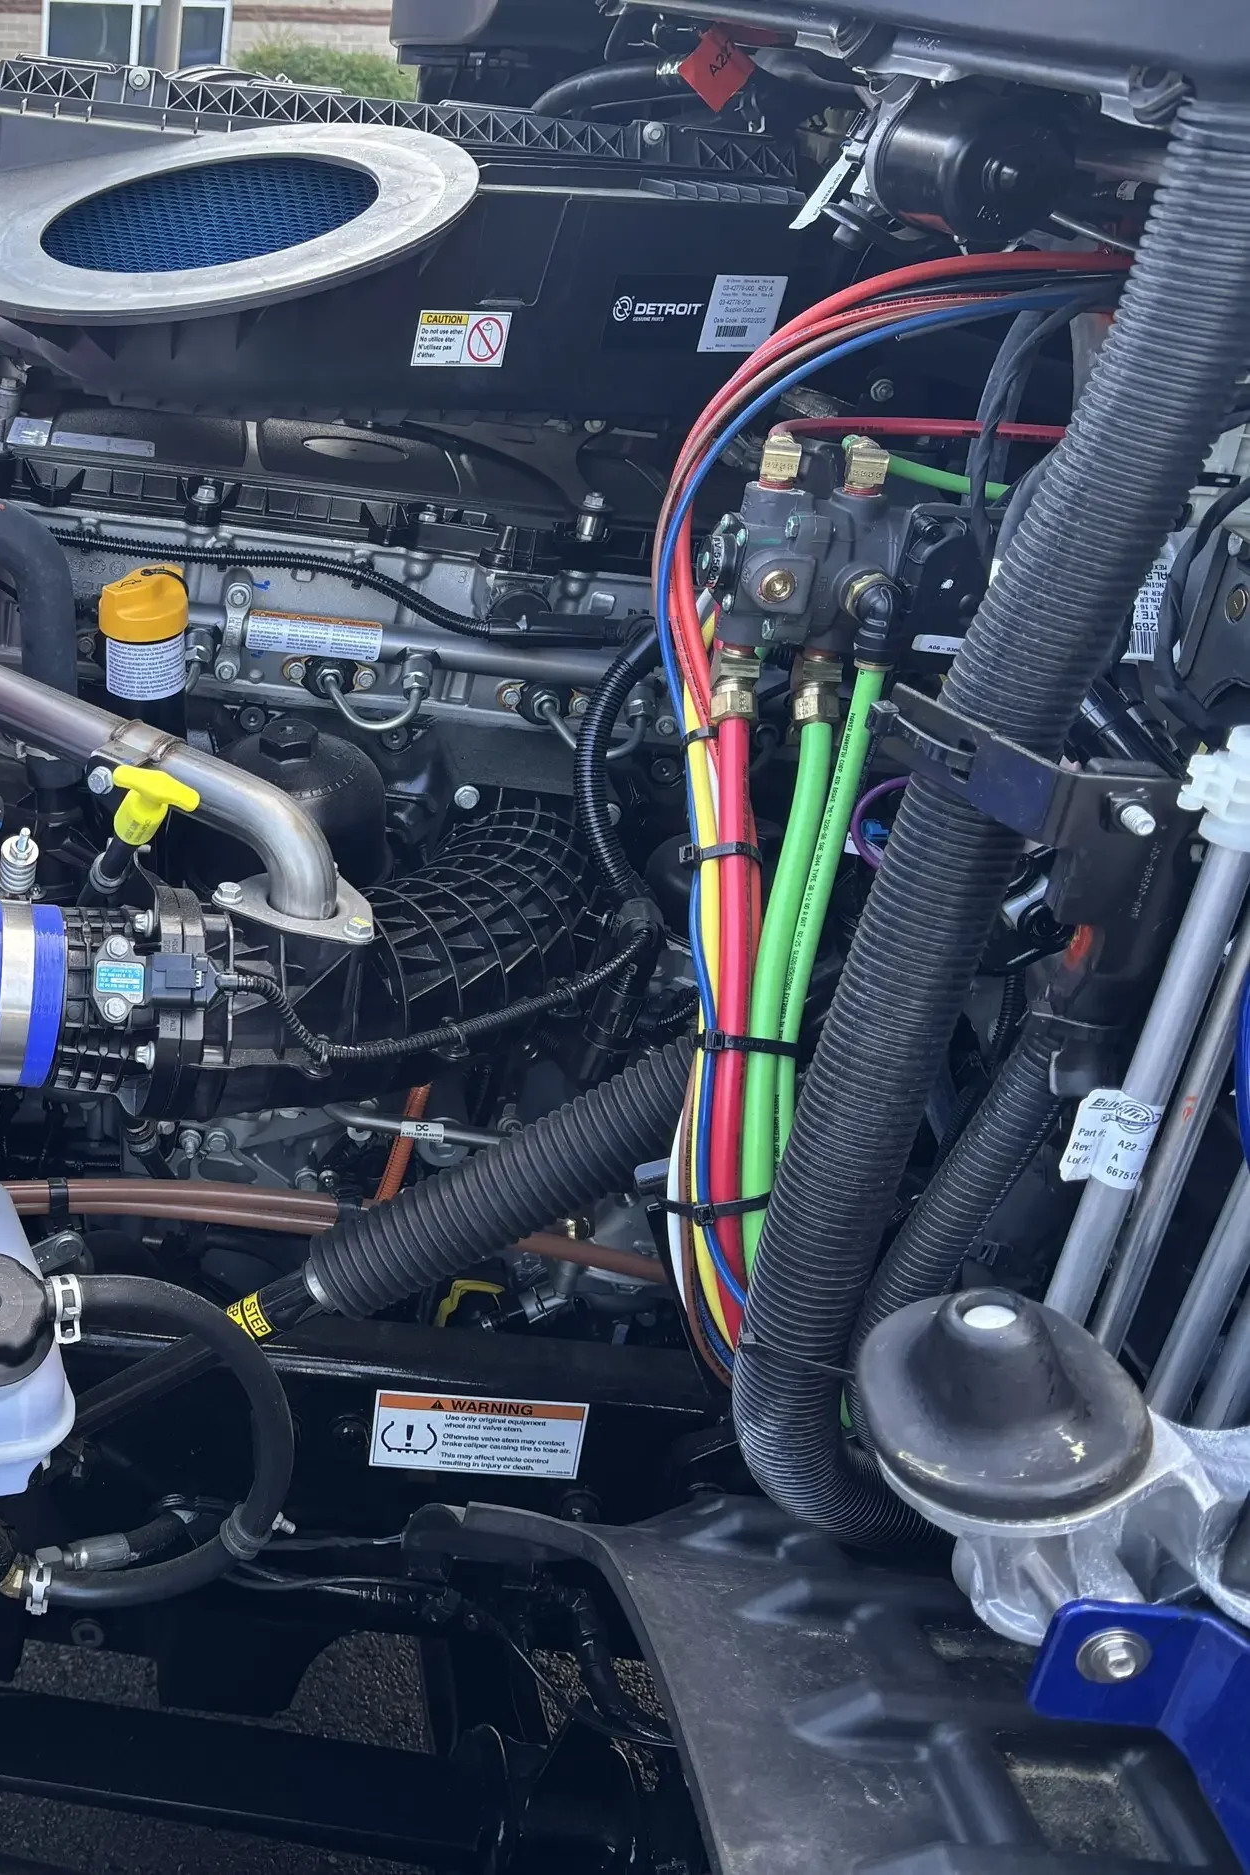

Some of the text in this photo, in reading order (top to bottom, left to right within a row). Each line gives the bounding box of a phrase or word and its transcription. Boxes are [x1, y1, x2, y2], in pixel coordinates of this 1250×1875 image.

[634, 303, 702, 315] DETROIT
[427, 315, 463, 324] CAUTION
[1078, 1128, 1097, 1137] Part
[1072, 1142, 1092, 1151] Rev:
[1066, 1155, 1081, 1164] Lot
[1112, 1153, 1118, 1162] A
[245, 1301, 269, 1333] STEP
[451, 1400, 534, 1416] WARNING
[461, 1416, 477, 1424] only
[478, 1417, 507, 1425] original
[507, 1419, 547, 1428] equipment
[442, 1433, 480, 1442] Otherwise
[537, 1439, 566, 1447] contact
[463, 1443, 489, 1451] caliper
[489, 1444, 518, 1453] causing
[542, 1446, 558, 1454] lose
[439, 1460, 471, 1468] resulting
[481, 1462, 502, 1470] injury
[473, 1454, 495, 1462] affect
[523, 1457, 549, 1465] control
